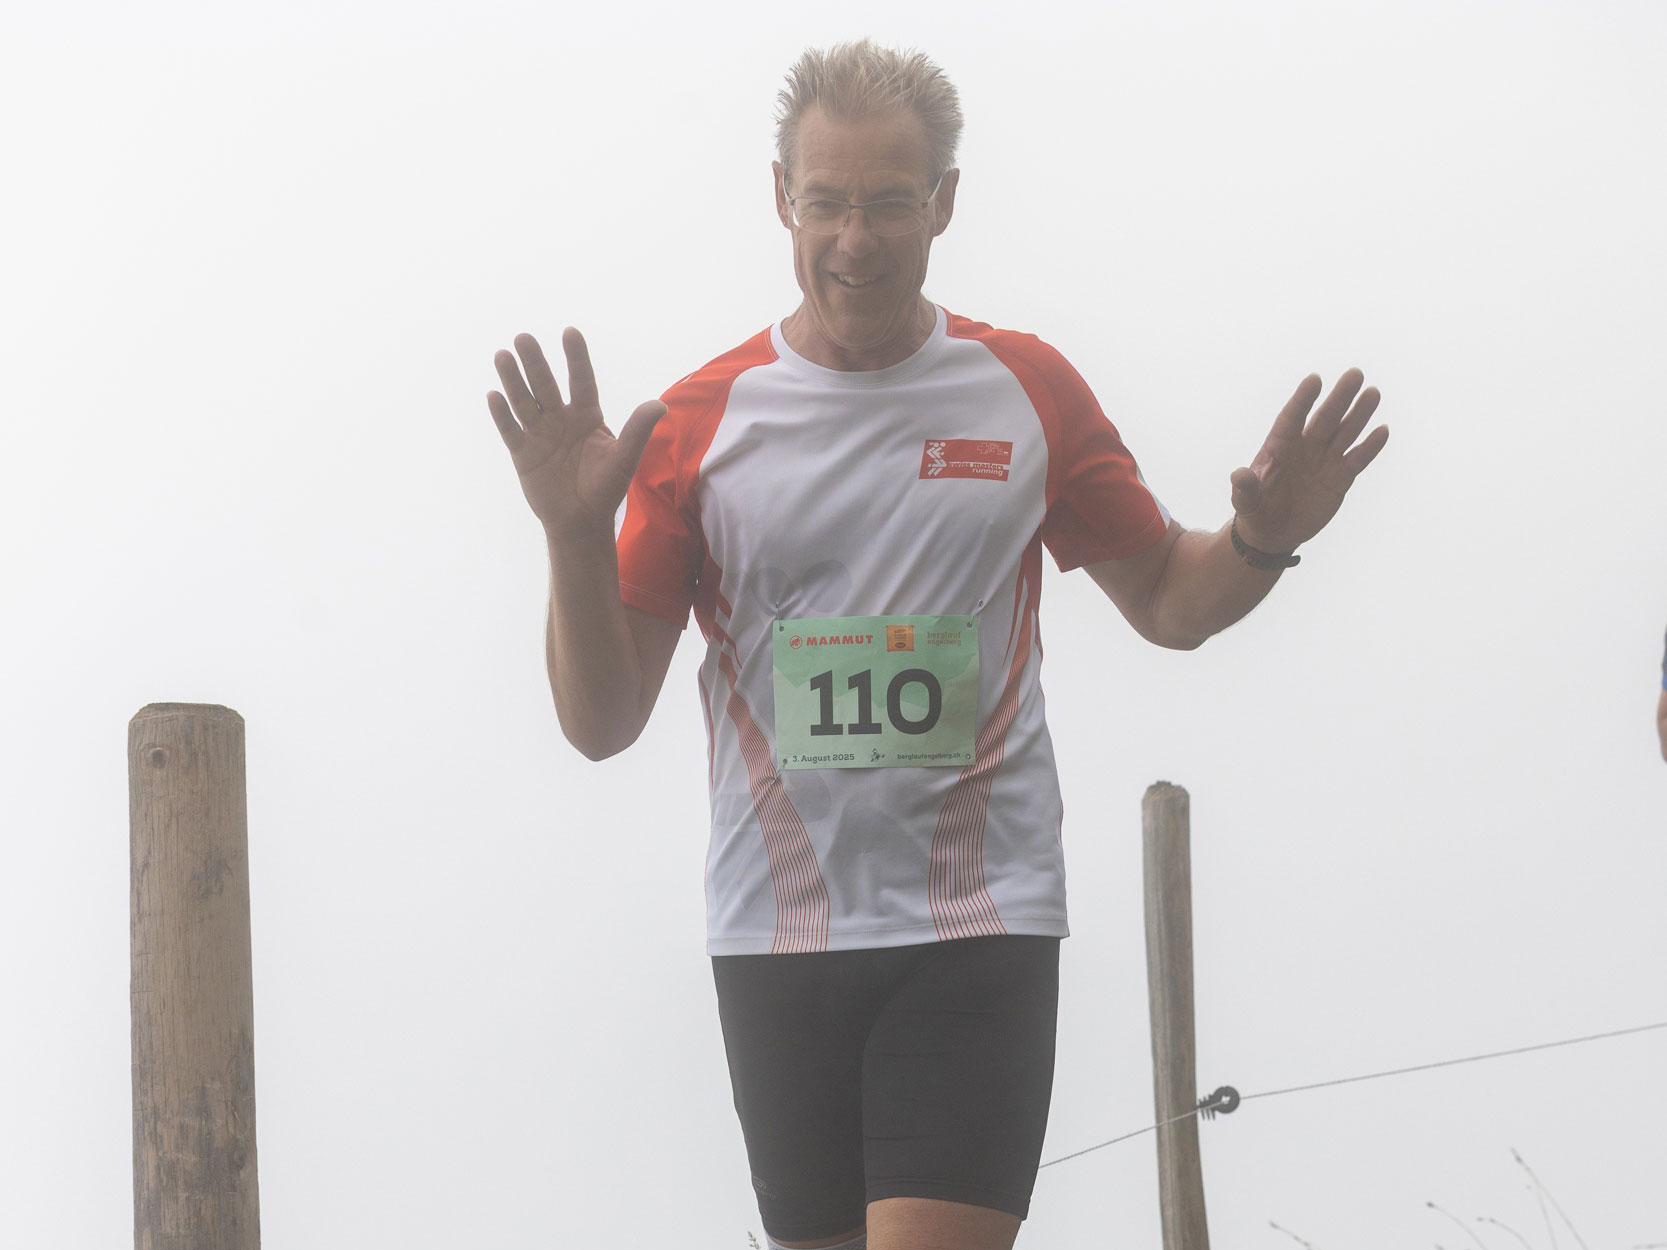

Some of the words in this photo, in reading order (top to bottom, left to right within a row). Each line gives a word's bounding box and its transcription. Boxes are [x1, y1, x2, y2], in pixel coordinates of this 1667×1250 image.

[972, 467, 1003, 477] running
[806, 634, 874, 646] MAMMUT
[927, 631, 961, 640] berglauf
[927, 639, 962, 647] engelberg
[810, 668, 942, 736] 110
[792, 755, 800, 763] 3.
[801, 755, 831, 764] August
[832, 753, 855, 761] 2025
[897, 752, 961, 760] berglaufengelberg.ch
